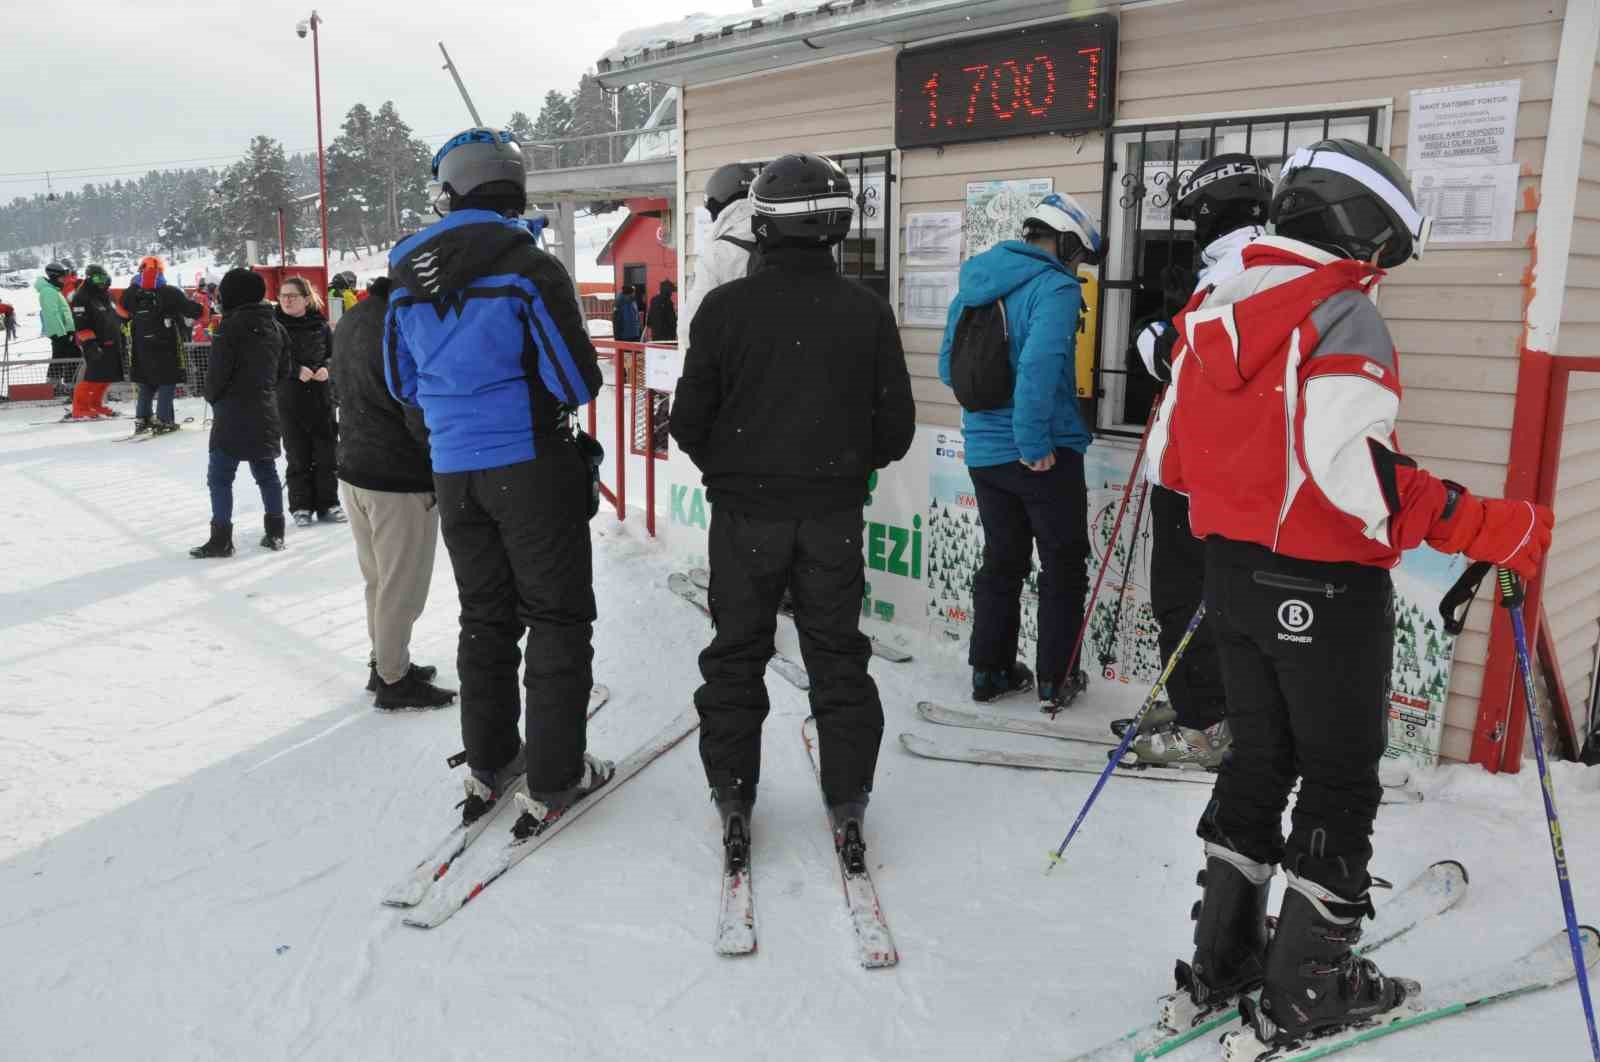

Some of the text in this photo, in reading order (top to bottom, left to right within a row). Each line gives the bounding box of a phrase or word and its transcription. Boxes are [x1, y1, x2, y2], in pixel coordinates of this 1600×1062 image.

[921, 55, 1056, 128] 1.700
[671, 484, 707, 530] KA
[863, 514, 922, 579] EZİ
